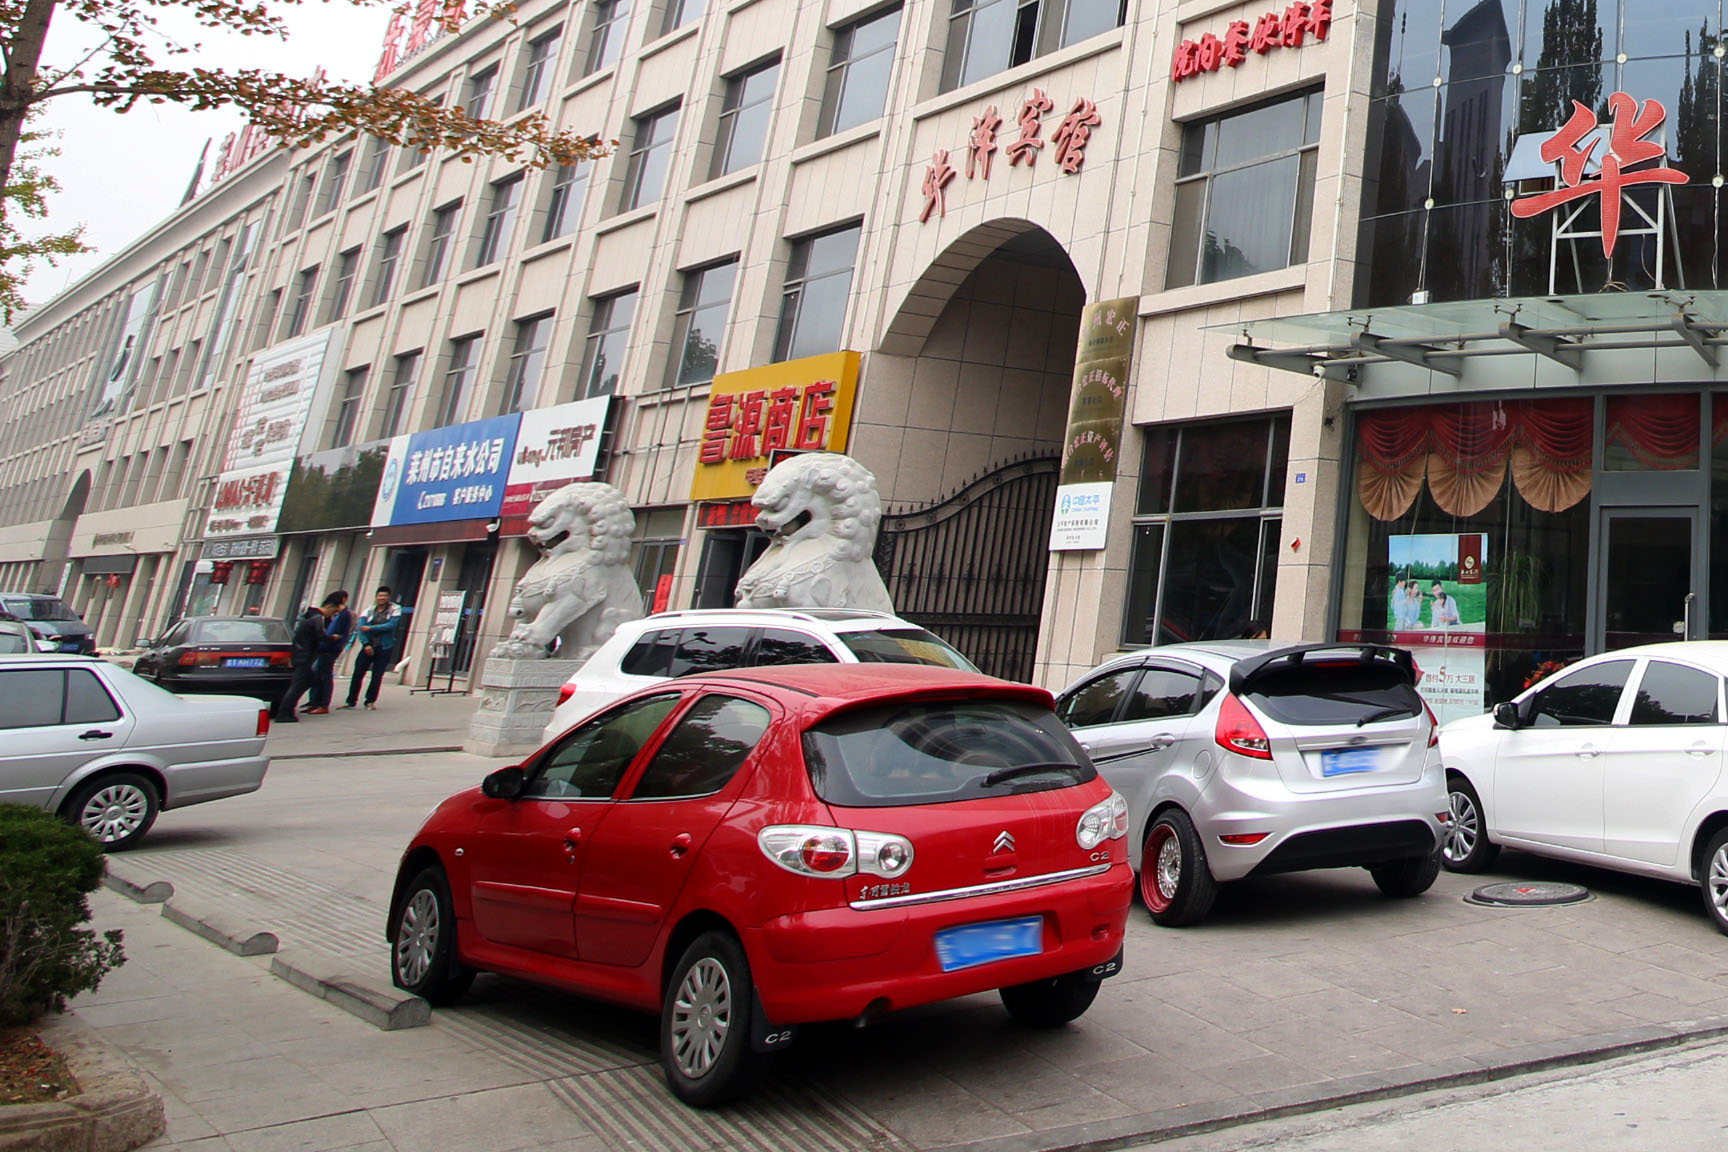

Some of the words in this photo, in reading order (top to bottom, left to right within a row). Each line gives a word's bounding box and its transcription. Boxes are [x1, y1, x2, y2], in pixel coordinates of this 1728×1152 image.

[919, 87, 1101, 223] 华泽宾馆
[1085, 309, 1130, 337] 州宏正
[699, 380, 838, 464] 鲁源商店
[405, 437, 505, 486] 莱州市自来水公司
[1089, 851, 1112, 862] C2
[1092, 962, 1116, 975] C2
[764, 1030, 792, 1044] C2
